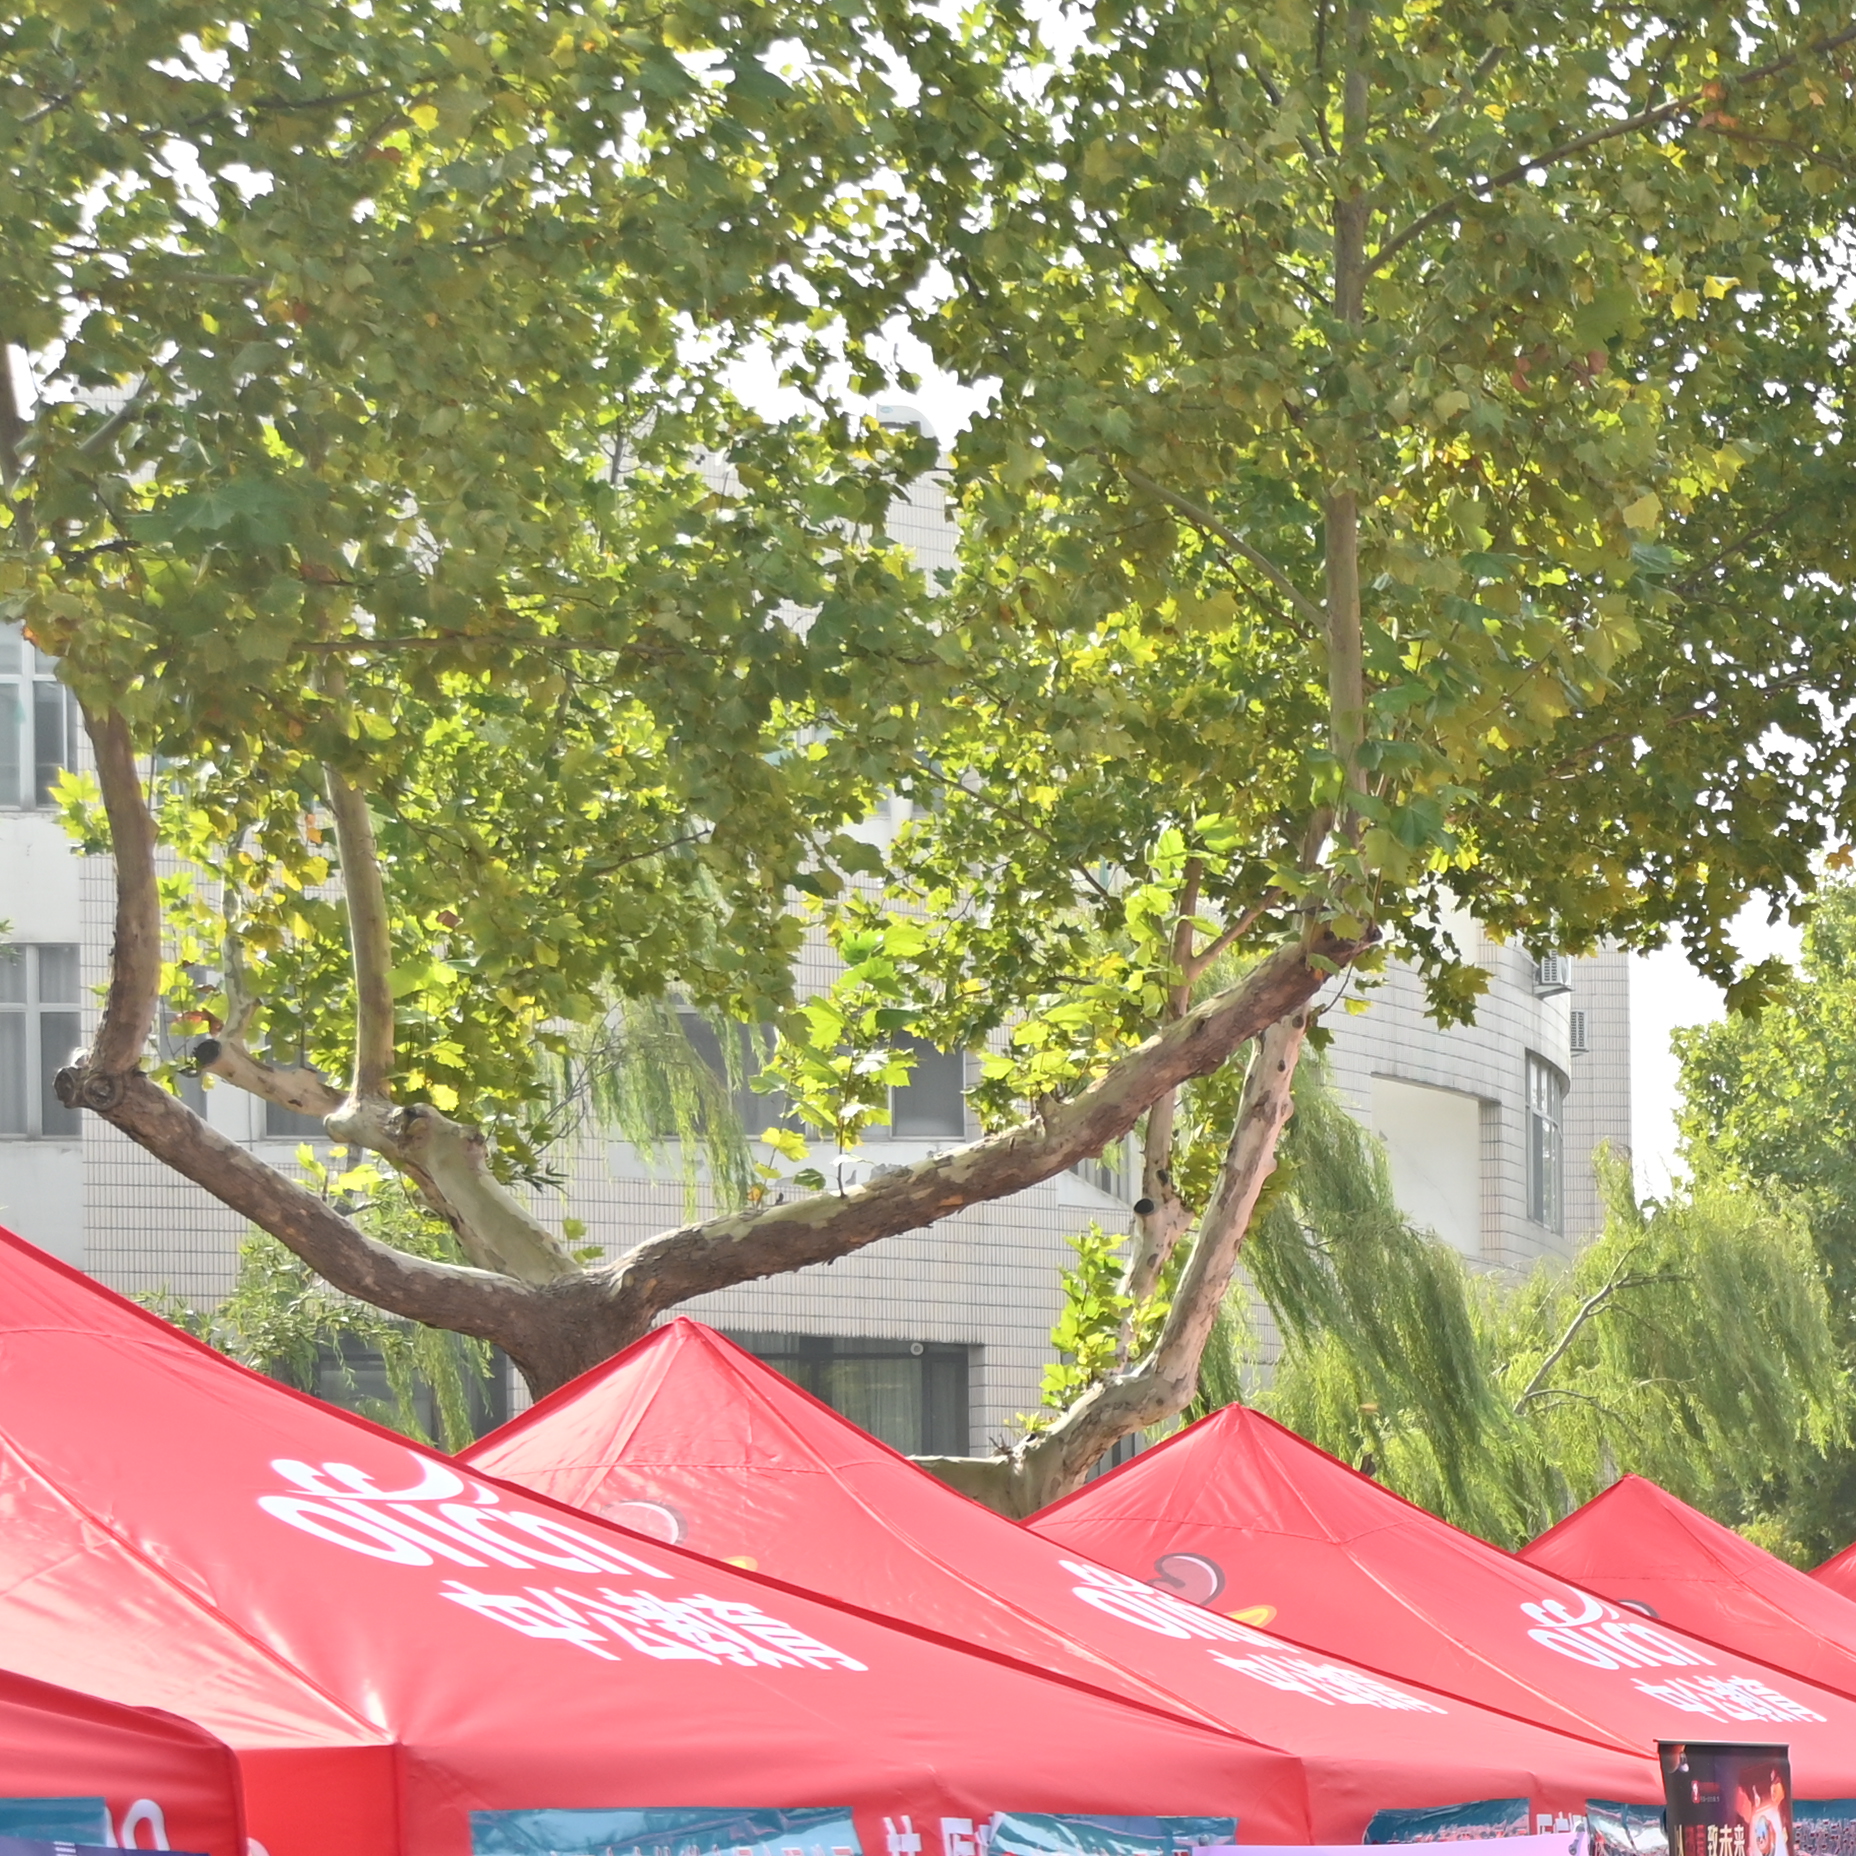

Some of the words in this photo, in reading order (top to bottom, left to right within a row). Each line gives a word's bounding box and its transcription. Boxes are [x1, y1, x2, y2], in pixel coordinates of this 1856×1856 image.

[438, 1580, 869, 1672] 中公教育
[1631, 1677, 1828, 1723] 中公教育
